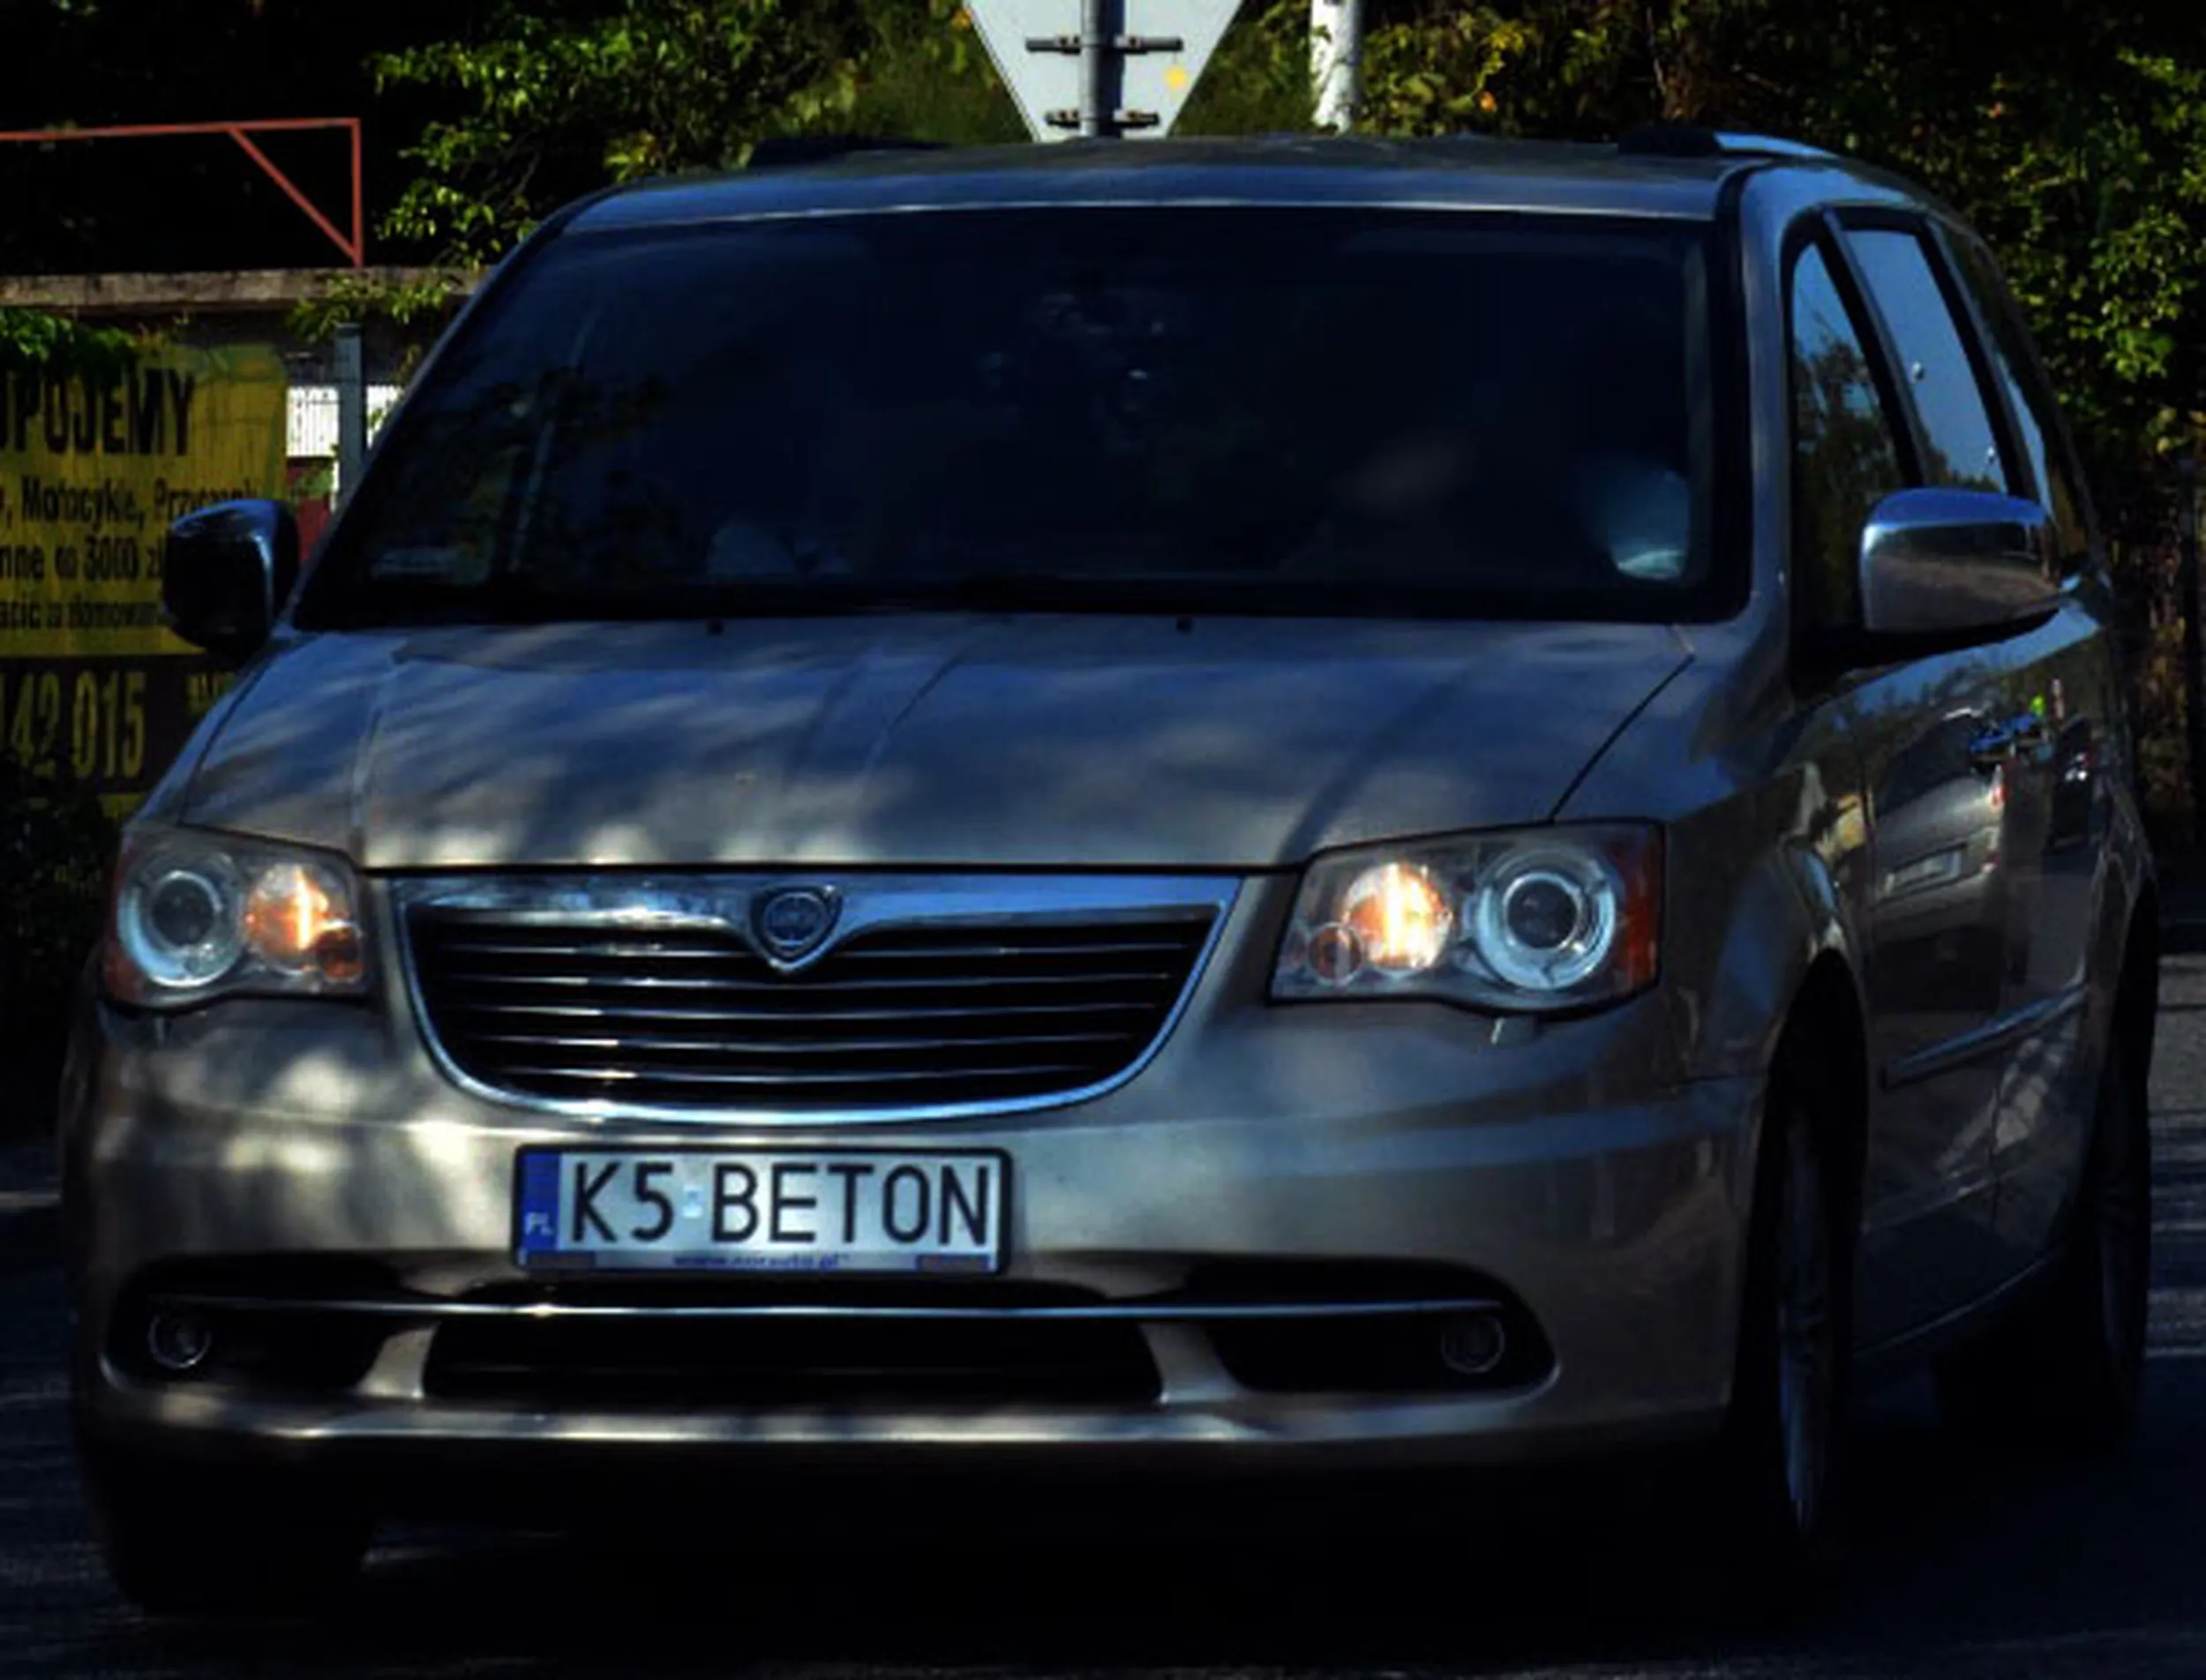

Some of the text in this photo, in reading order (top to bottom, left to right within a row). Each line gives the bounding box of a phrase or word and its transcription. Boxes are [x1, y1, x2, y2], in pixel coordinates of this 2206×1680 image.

[0, 368, 194, 454] PUJEMY
[71, 668, 146, 779] 015
[571, 1161, 989, 1246] K5 BETON
